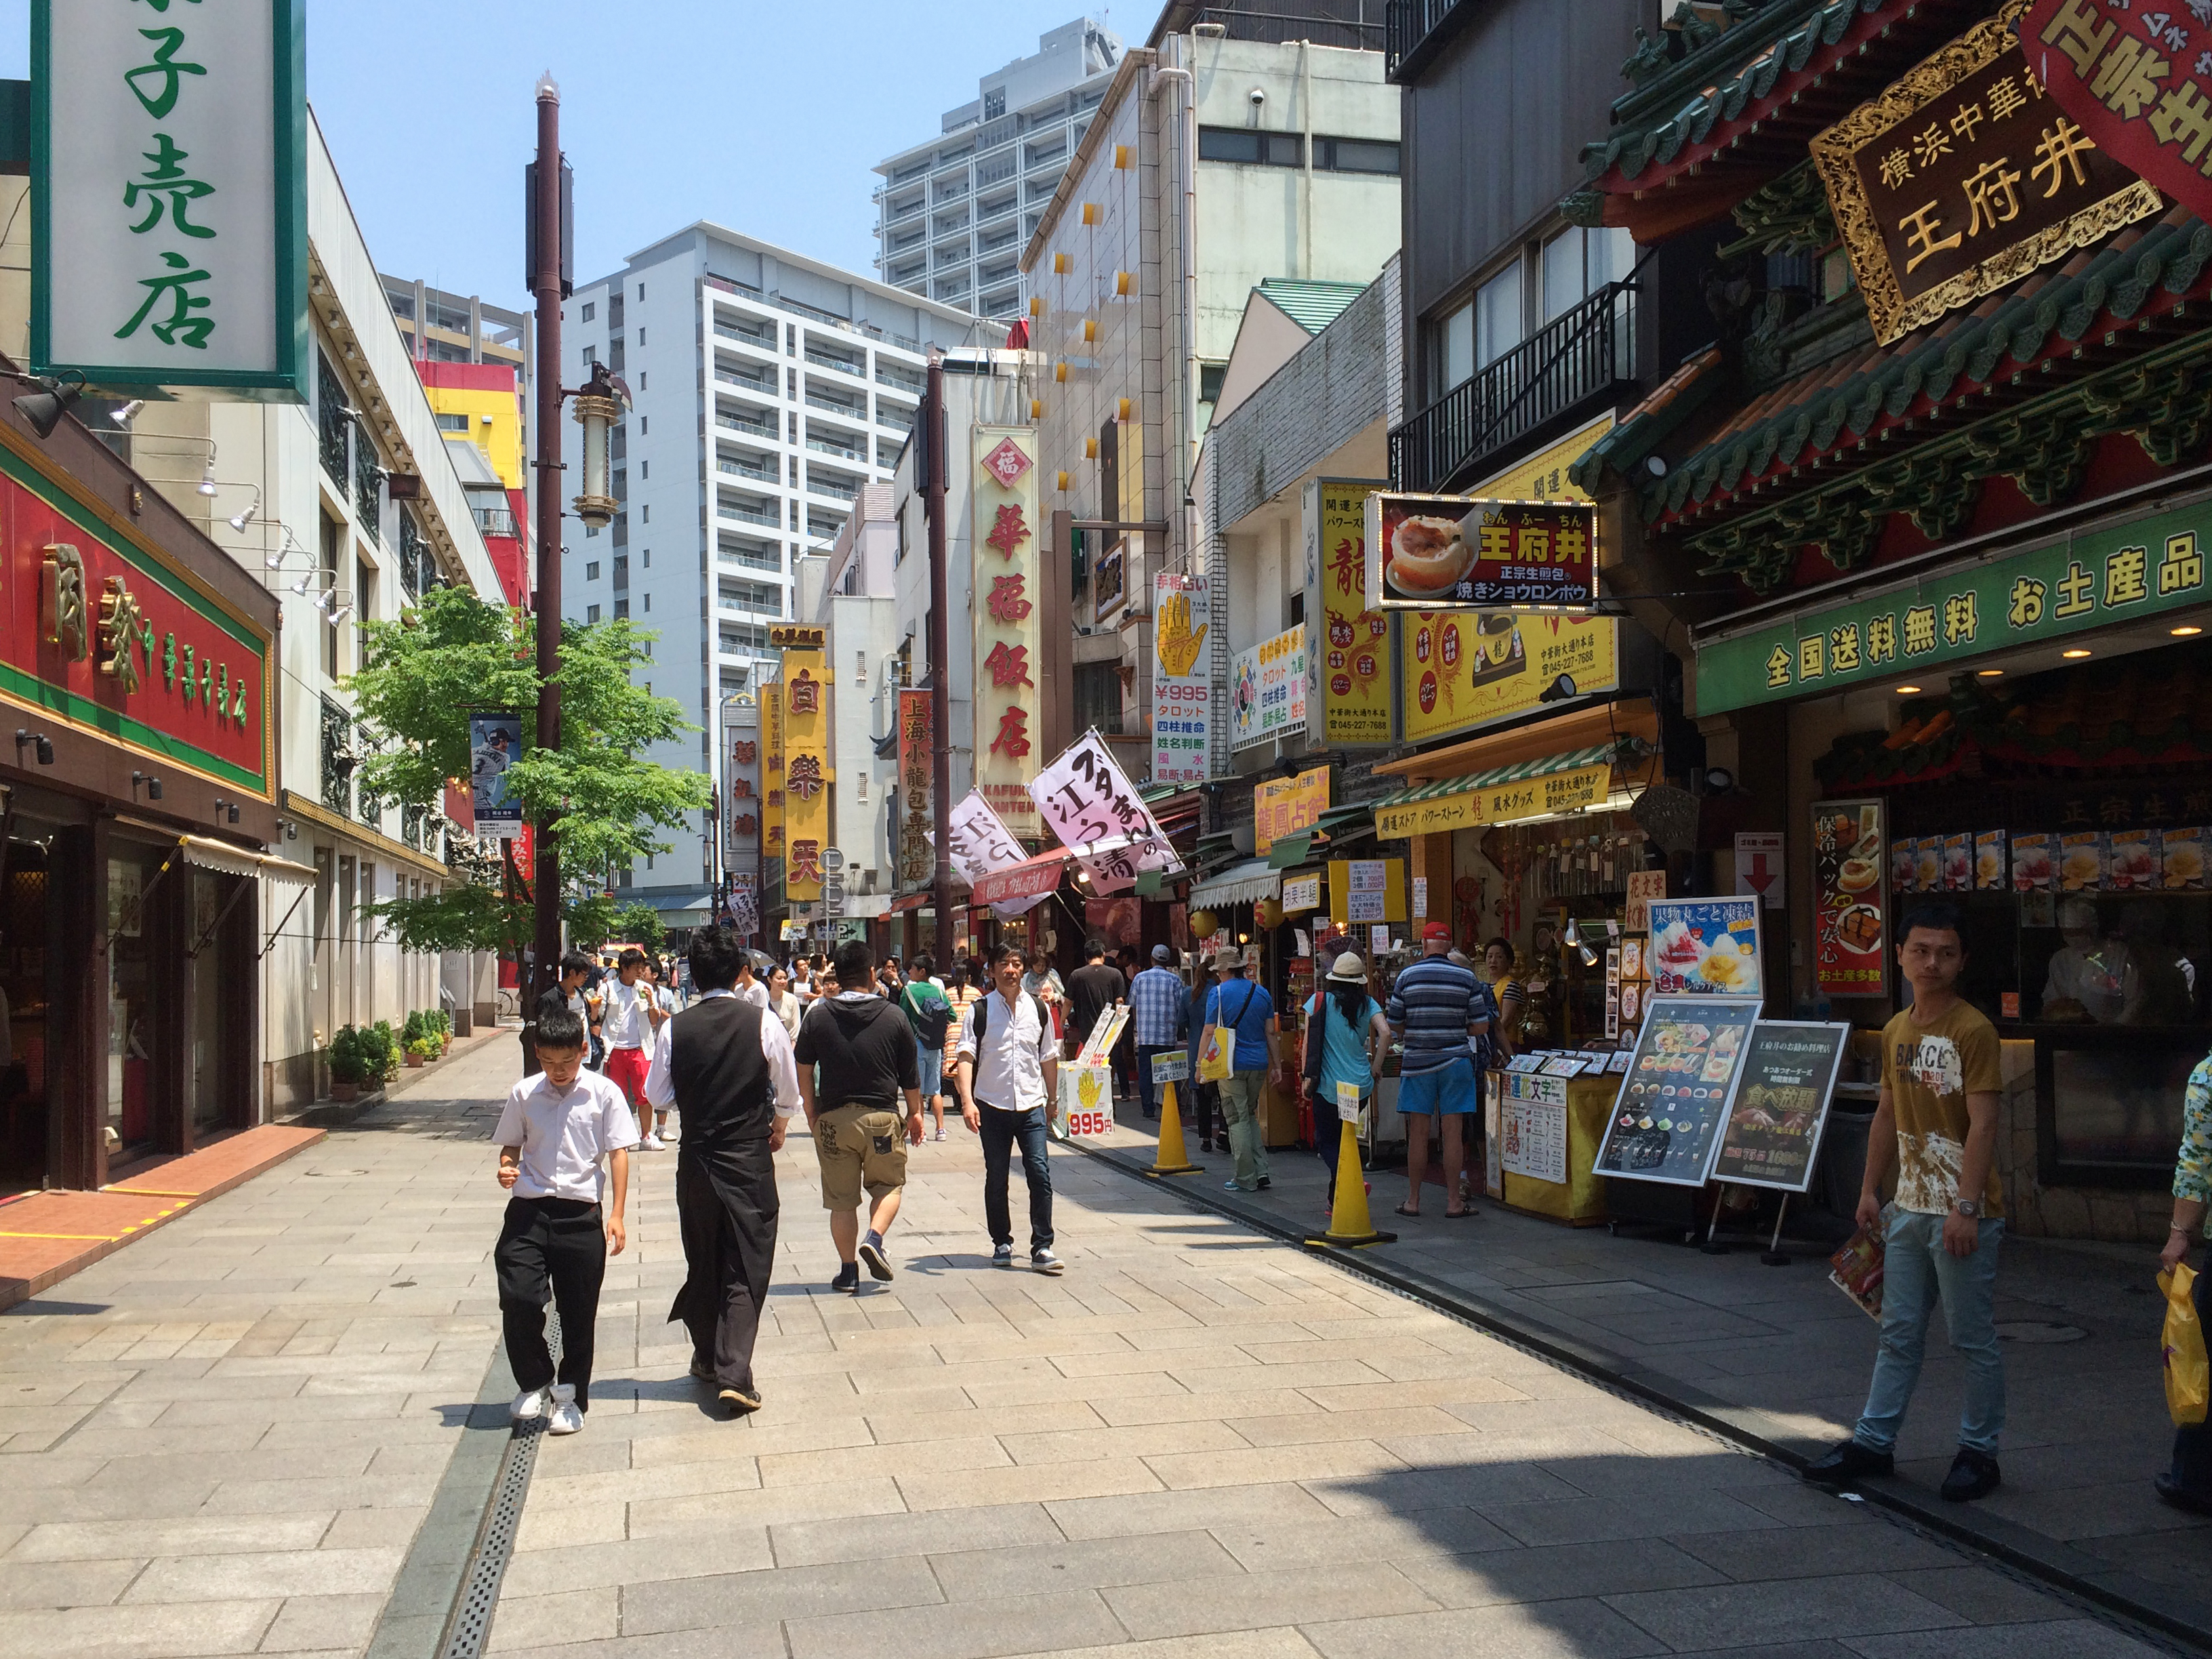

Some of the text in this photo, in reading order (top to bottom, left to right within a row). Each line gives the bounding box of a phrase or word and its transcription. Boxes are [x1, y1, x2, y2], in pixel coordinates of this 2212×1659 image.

[2040, 0, 2212, 178] 正宗生
[112, 0, 217, 350] 子売店
[1898, 117, 2096, 275] 王府井
[996, 450, 1019, 475] 福
[1326, 499, 1364, 512] 開運ス
[1326, 516, 1365, 529] パワースト
[1483, 511, 1582, 527] わん ふー ちん
[1479, 525, 1587, 564] 王府井
[1155, 575, 1208, 592] 手相占い
[1500, 566, 1565, 581] 正宗生煎包
[1456, 581, 1588, 601] 焼きショウロンポウ
[1766, 530, 2204, 690] 全国送料無料 お土産品
[984, 504, 1034, 758] 華福飯店
[1331, 626, 1352, 637] 風水
[1332, 636, 1351, 644] グッズ
[1540, 632, 1595, 663] 中華街大通り本店
[1290, 655, 1304, 676] 九星
[1549, 650, 1594, 674] 045-227-7688
[1263, 664, 1286, 687] タロット
[1155, 685, 1208, 701] ¥995
[1261, 684, 1287, 708] 四柱推命
[1158, 707, 1205, 718] タロット
[1290, 700, 1305, 720] 姓名
[1329, 708, 1387, 717] 中華街大通り本店
[1157, 720, 1205, 733] 四柱推命
[1338, 720, 1387, 730] 045-227-7688
[1156, 737, 1205, 750] 姓名判断
[984, 784, 1027, 796] KAFUK
[1420, 805, 1466, 823] パワーストーン
[1471, 795, 1483, 821] 龍
[1493, 787, 1534, 813] 風水グッズ
[1284, 882, 1317, 907] 甘栗半額
[1630, 874, 1664, 899] 花文字
[699, 911, 712, 926] Ch
[1656, 903, 1754, 924] 果物丸ごと凍結
[838, 925, 848, 939] P
[1819, 969, 1881, 983] お土産多数
[1502, 1073, 1552, 1103] 開運花文字
[1744, 1083, 1819, 1113] 食べ放題
[1069, 1111, 1112, 1136] 995円
